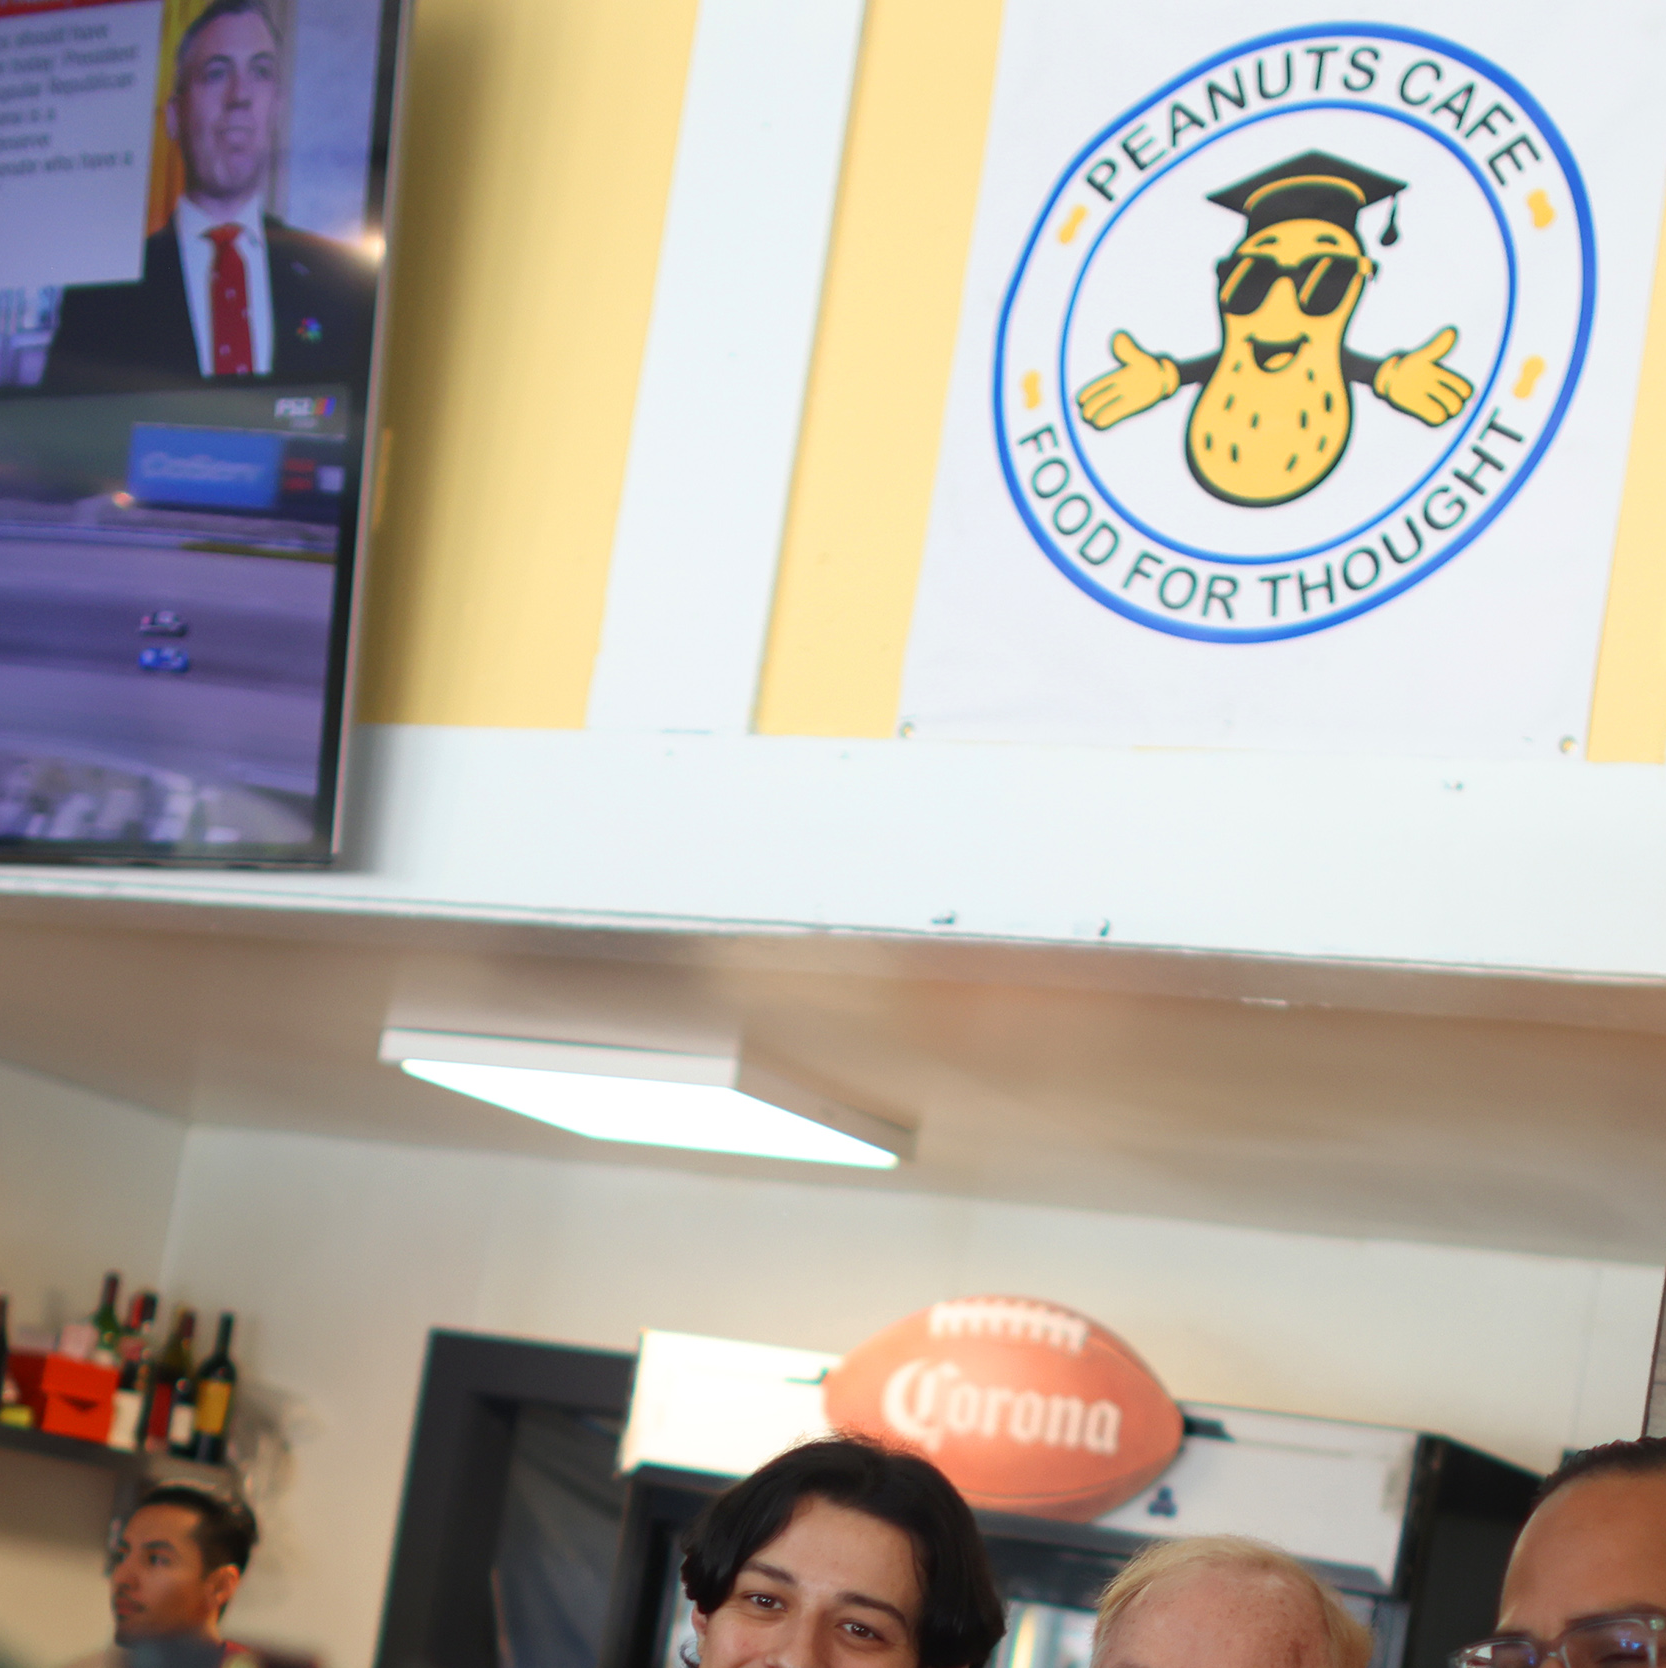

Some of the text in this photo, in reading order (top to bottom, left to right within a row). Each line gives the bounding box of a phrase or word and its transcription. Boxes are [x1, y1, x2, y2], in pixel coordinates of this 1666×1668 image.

[1085, 46, 1543, 202] PEANUTS CAFE
[1017, 409, 1526, 620] FOOD FOR THOUGHT
[882, 1356, 1123, 1456] Corona
